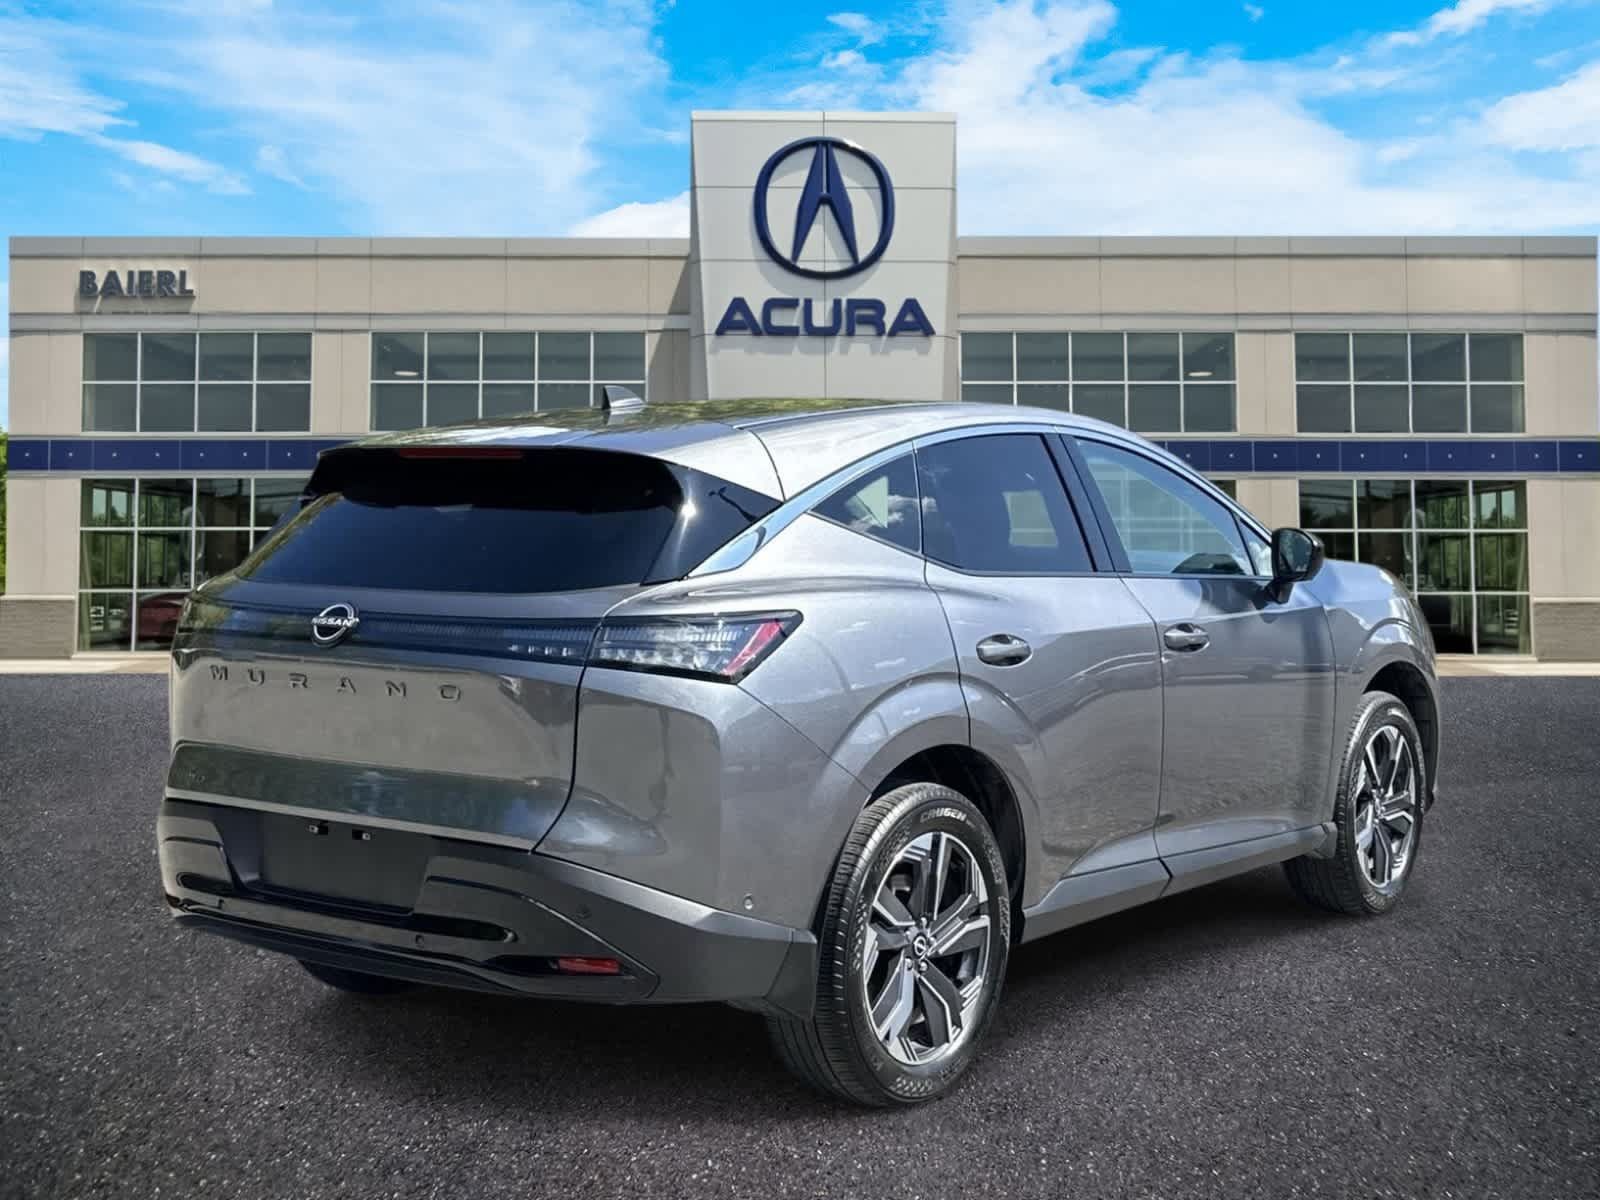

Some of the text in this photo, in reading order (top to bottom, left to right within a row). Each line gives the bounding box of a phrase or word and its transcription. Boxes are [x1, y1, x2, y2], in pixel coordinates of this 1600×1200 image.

[79, 270, 194, 297] BAIERL
[715, 297, 936, 337] ACURA
[311, 616, 353, 627] NISSAN
[210, 664, 462, 701] MURANO
